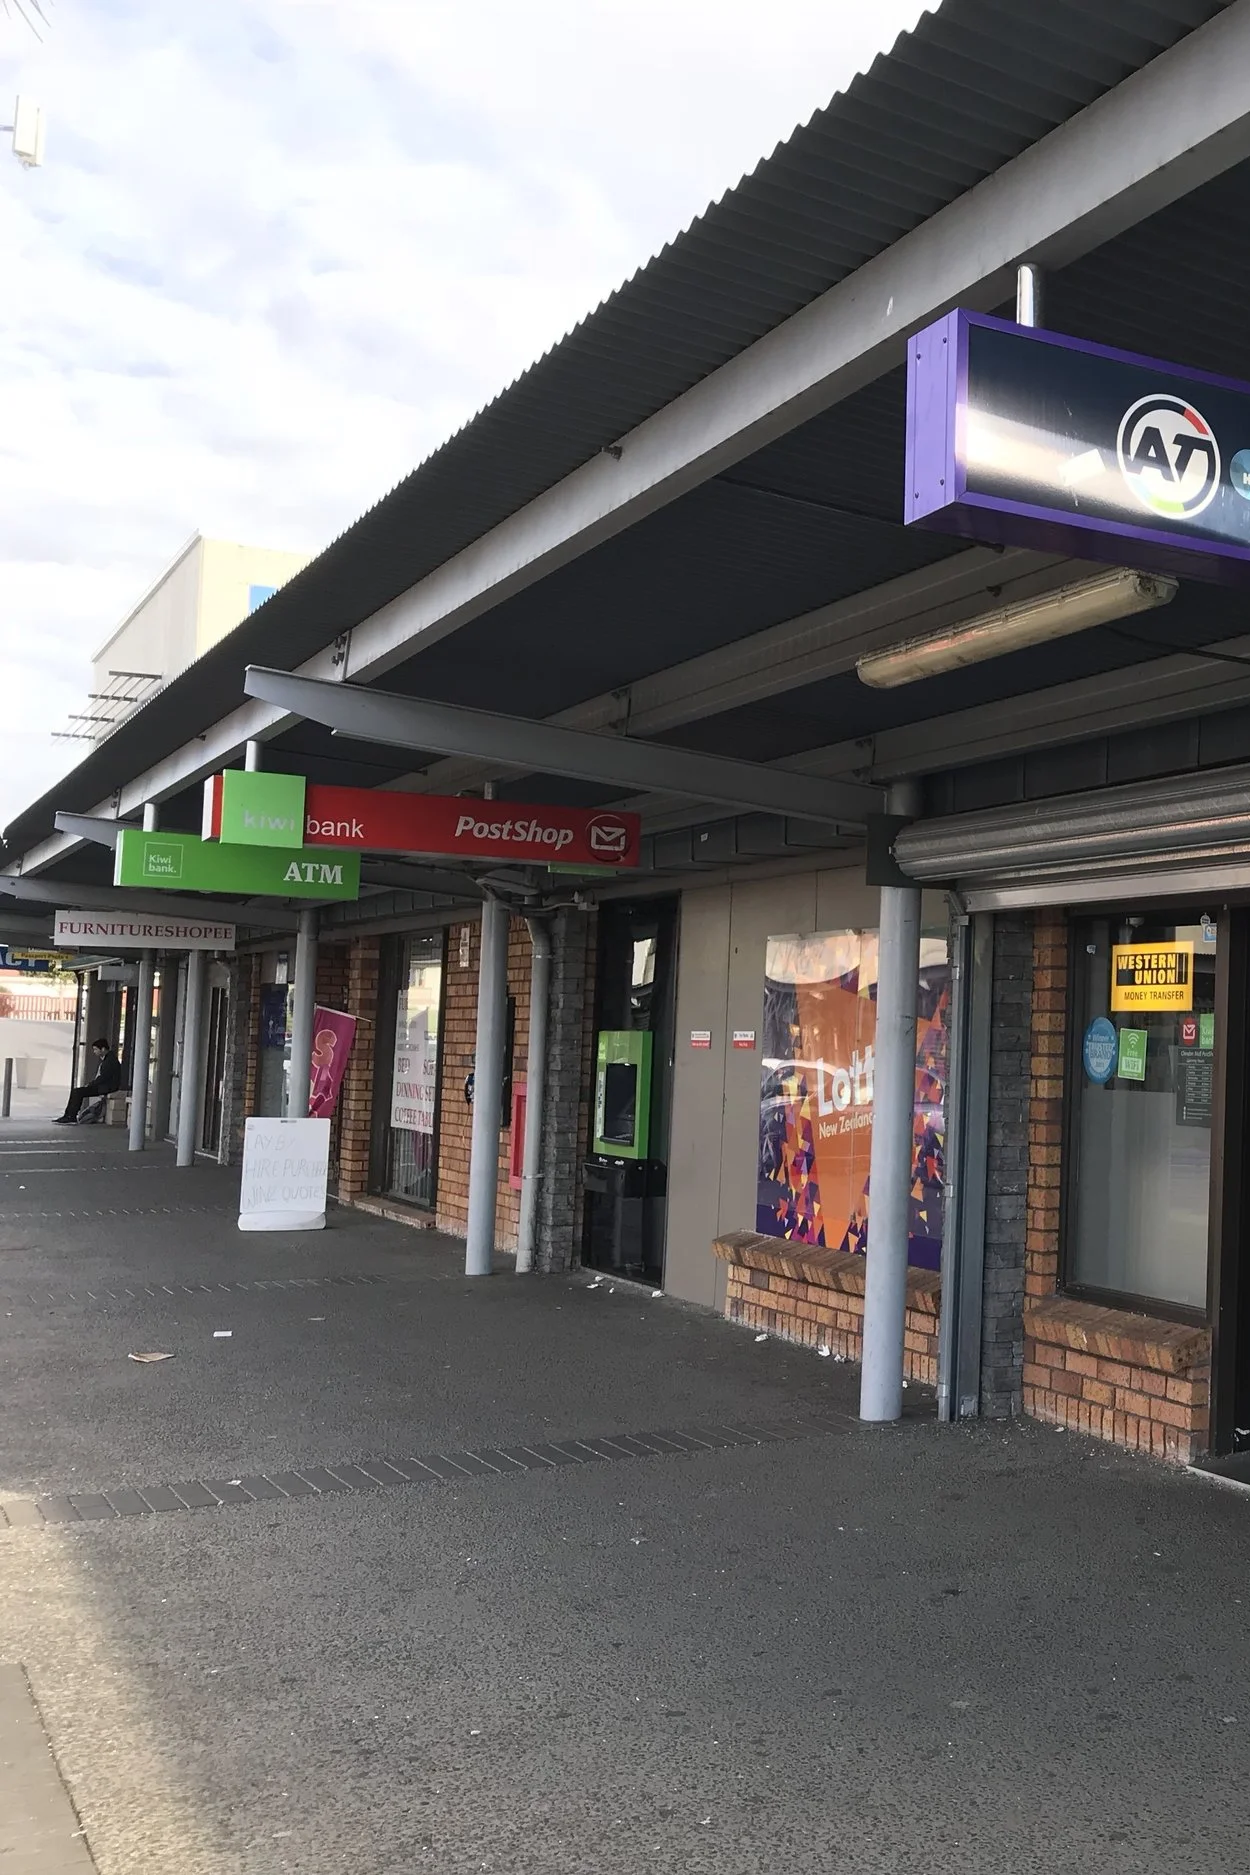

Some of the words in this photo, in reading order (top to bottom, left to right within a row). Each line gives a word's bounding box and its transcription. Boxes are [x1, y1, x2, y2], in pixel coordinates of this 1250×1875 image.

[243, 809, 295, 831] kiwi
[306, 815, 364, 838] bank
[455, 816, 574, 850] PostShop
[148, 854, 172, 864] Kiwi
[283, 861, 343, 885] ATM
[59, 921, 233, 940] FURNITURESHOPEE
[1117, 953, 1176, 970] WESTERN
[1134, 969, 1176, 985] UNION
[1124, 991, 1147, 1000] MONEY
[1150, 990, 1184, 1000] TRANSFER
[816, 1045, 876, 1117] Lott
[819, 1121, 837, 1140] New
